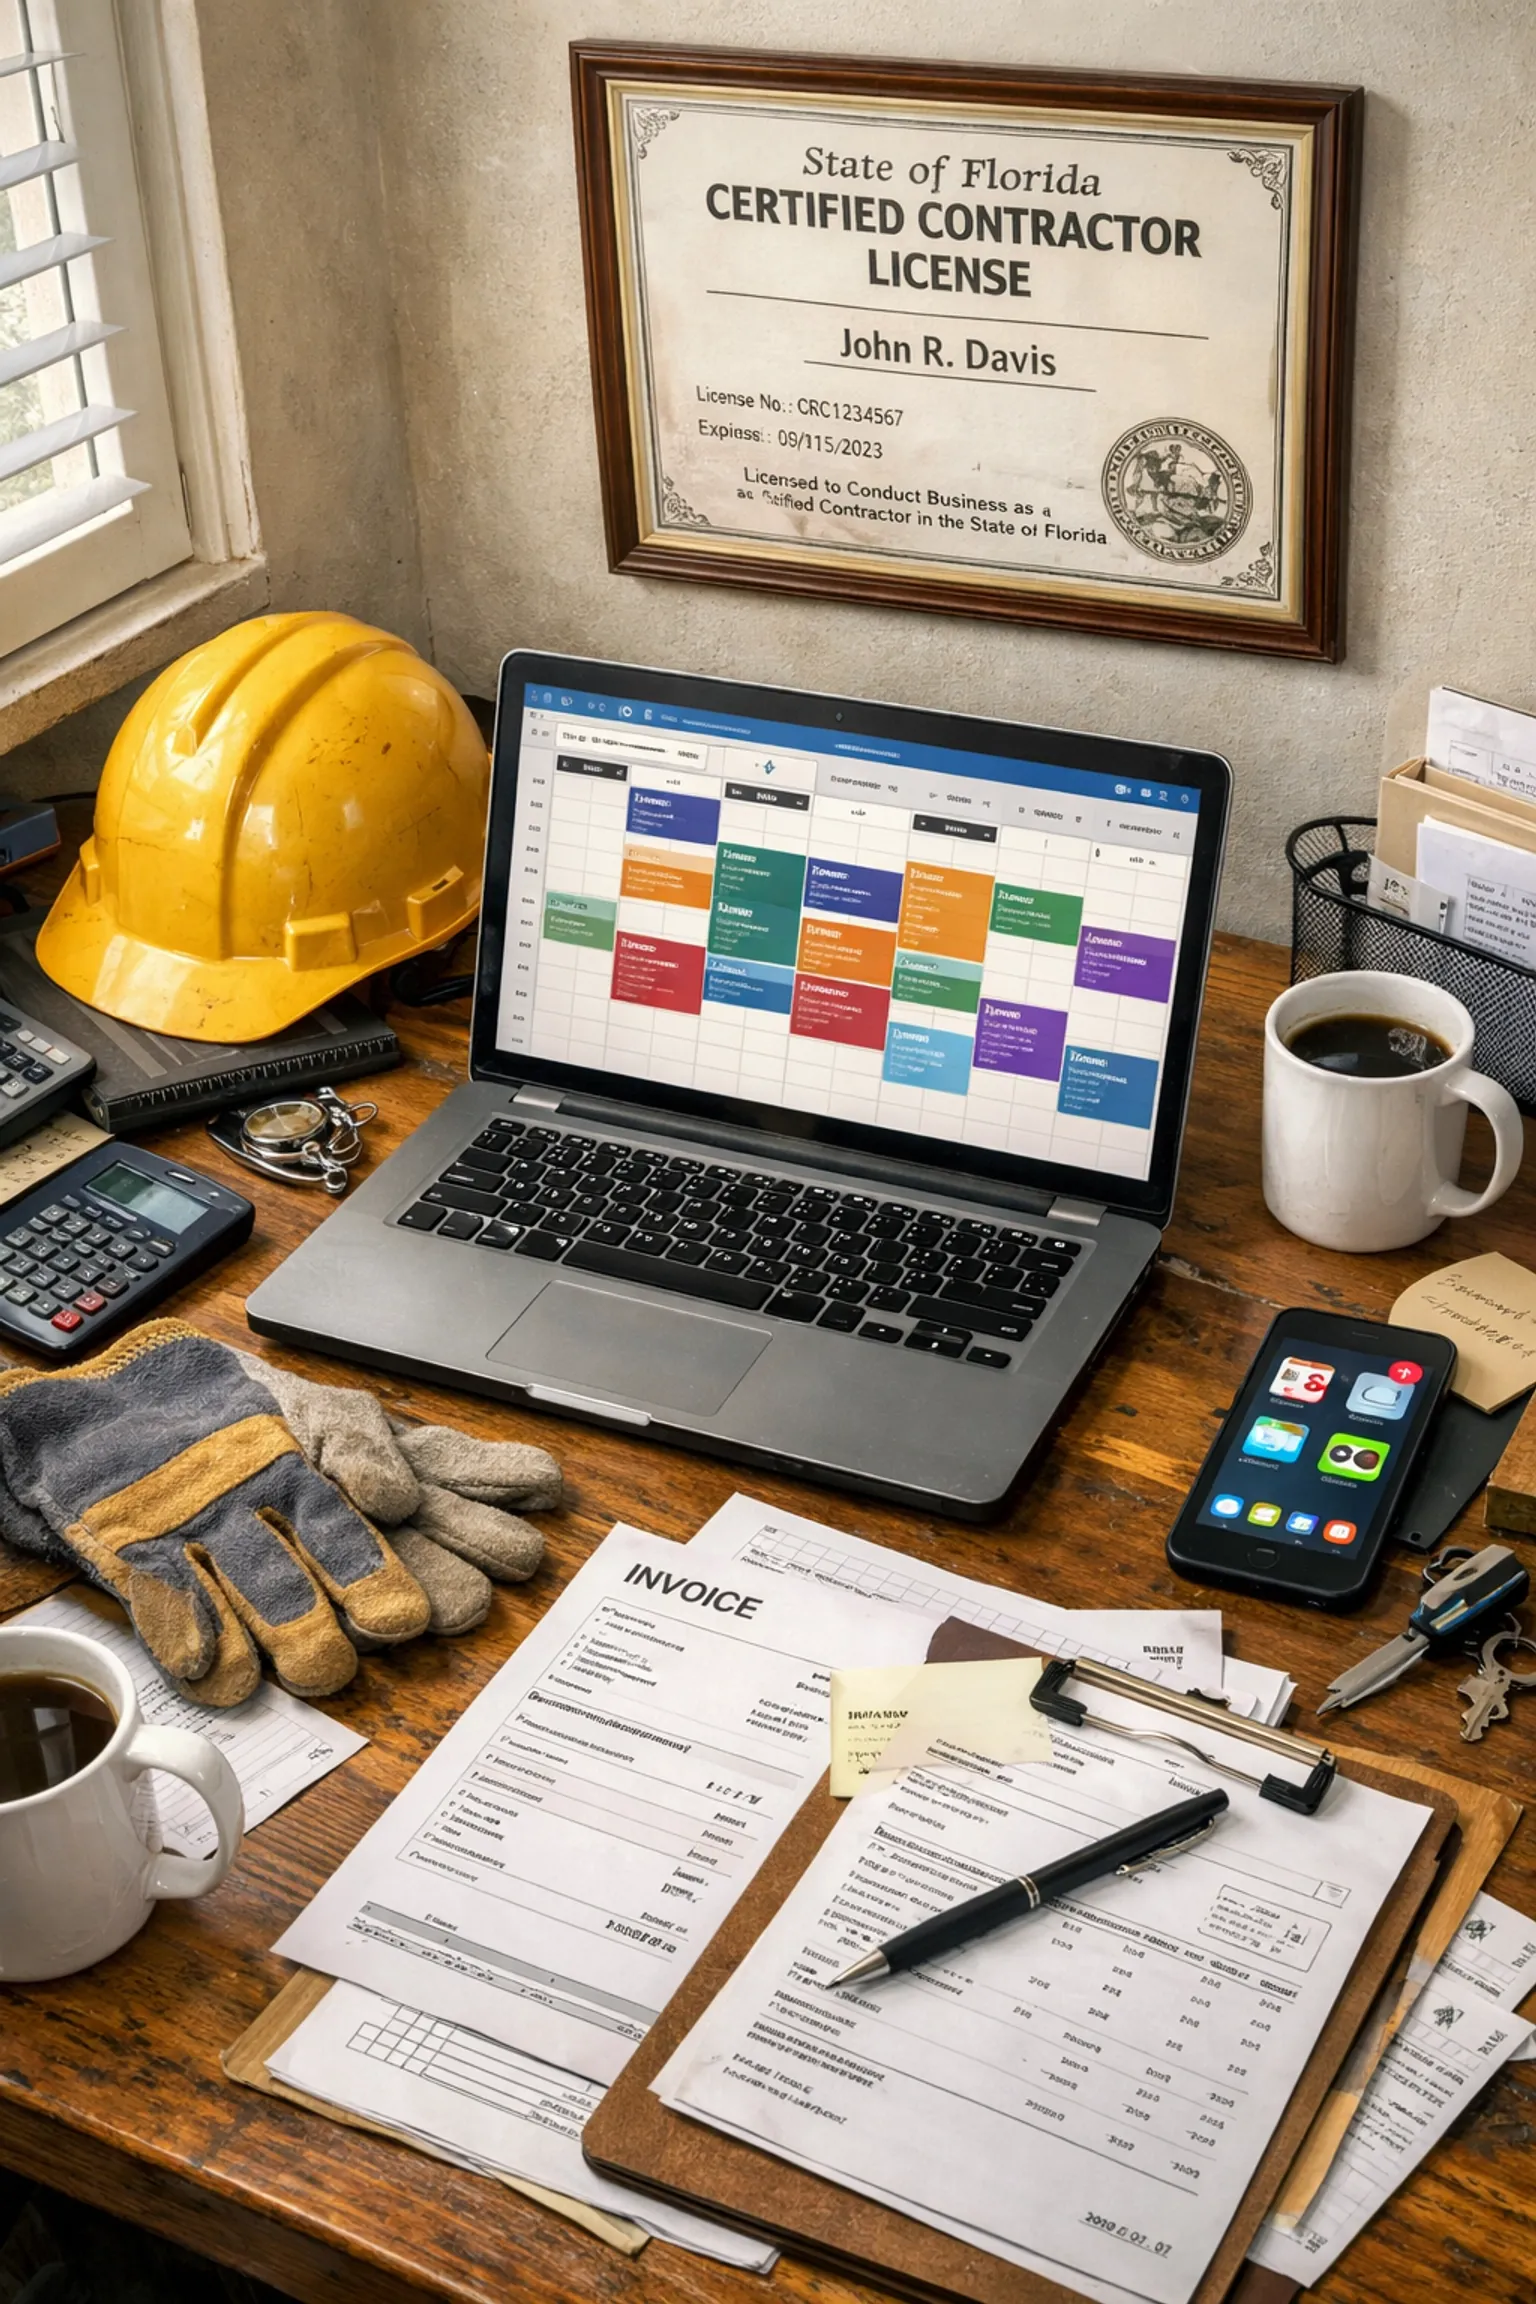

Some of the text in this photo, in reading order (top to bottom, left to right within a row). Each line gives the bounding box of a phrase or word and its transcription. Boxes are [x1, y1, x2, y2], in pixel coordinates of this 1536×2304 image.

[803, 146, 1102, 197] State of Florida
[706, 183, 1202, 258] CERTIFIED CONTRACTOR
[868, 249, 1032, 298] LICENSE
[840, 328, 1056, 376] John R. Davis
[696, 385, 755, 408] License
[797, 397, 904, 426] CRC1234567
[744, 467, 1051, 518] Licensed to Conduct Business as a
[819, 499, 912, 525] Contractor
[917, 511, 932, 526] in
[938, 514, 964, 530] the
[970, 516, 1015, 535] State
[1021, 523, 1038, 537] of
[1045, 524, 1108, 545] Florida
[623, 1563, 764, 1620] INVOICE
